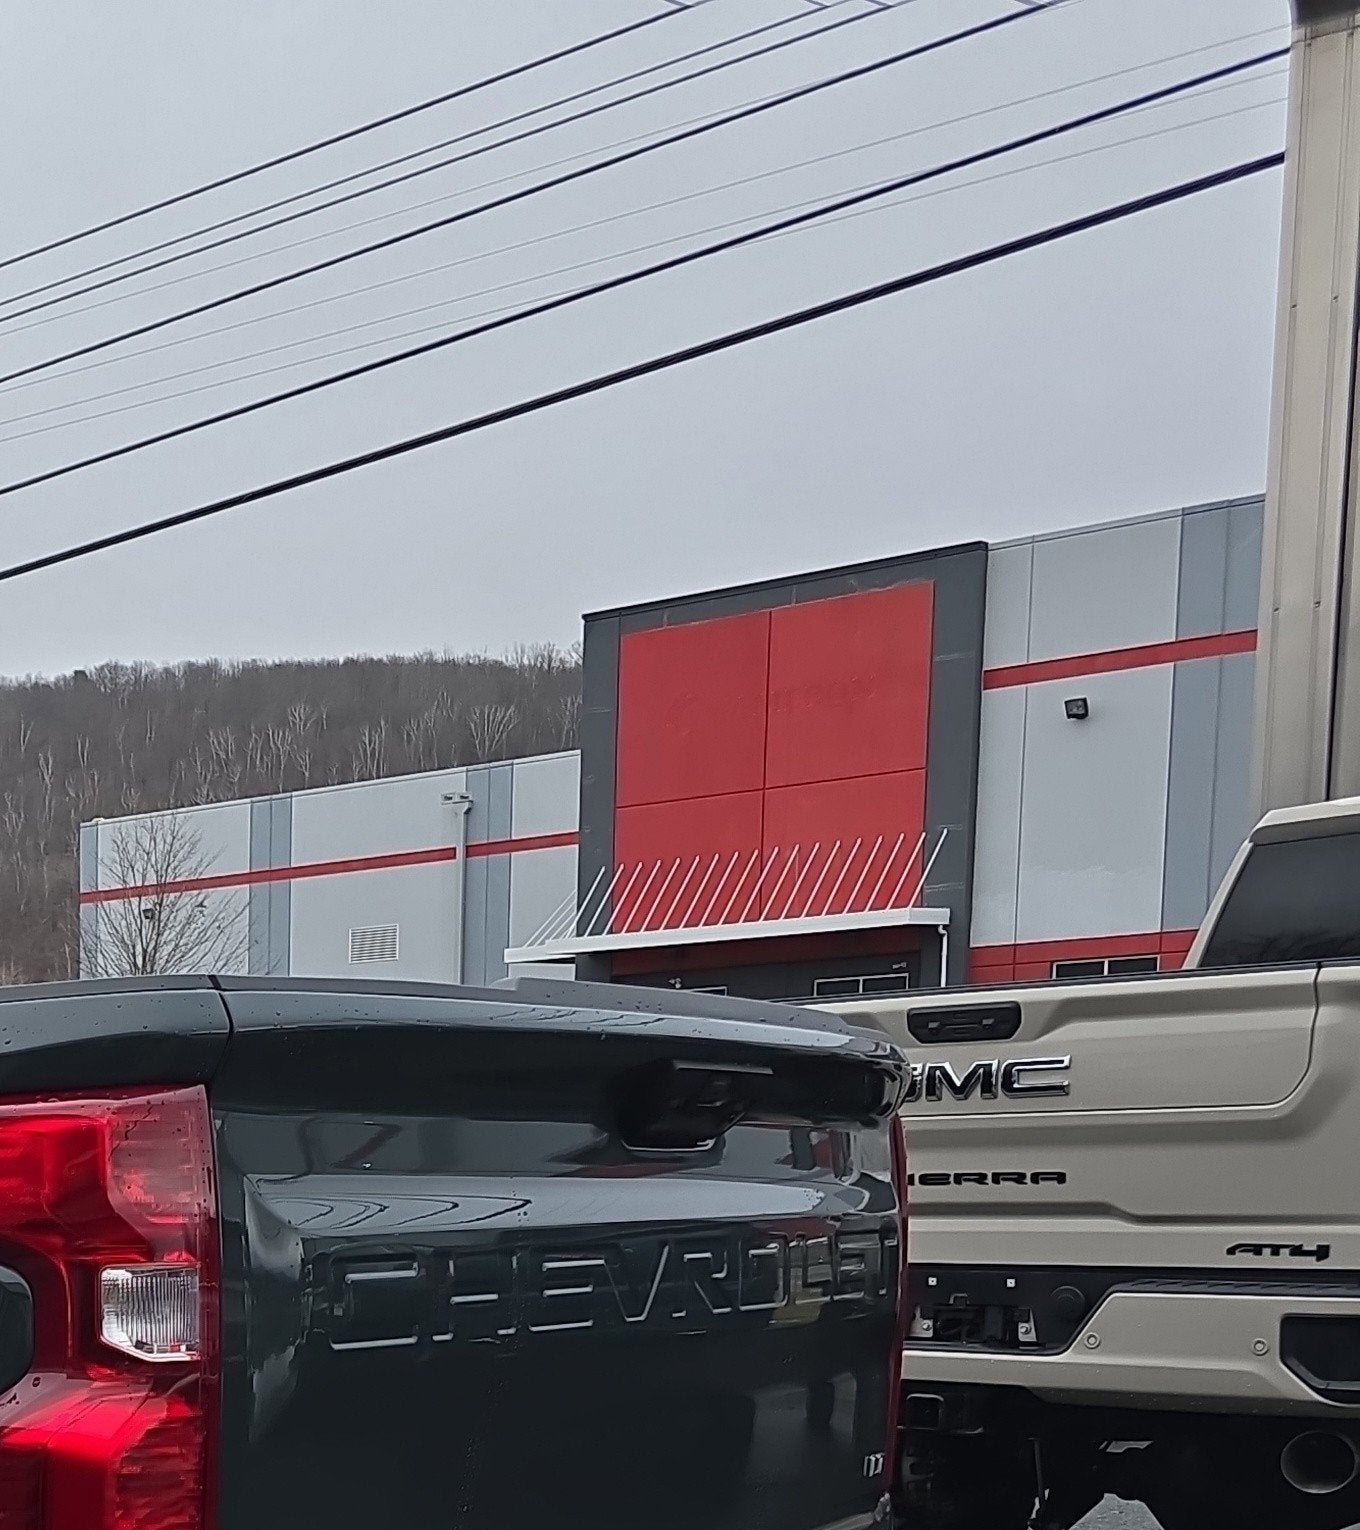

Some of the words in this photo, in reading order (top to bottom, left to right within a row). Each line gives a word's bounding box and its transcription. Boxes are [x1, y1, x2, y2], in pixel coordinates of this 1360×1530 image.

[905, 1055, 1072, 1101] MC
[907, 1171, 1067, 1186] IERRA
[1226, 1243, 1330, 1262] AT4
[330, 1232, 898, 1351] CHEVROLET
